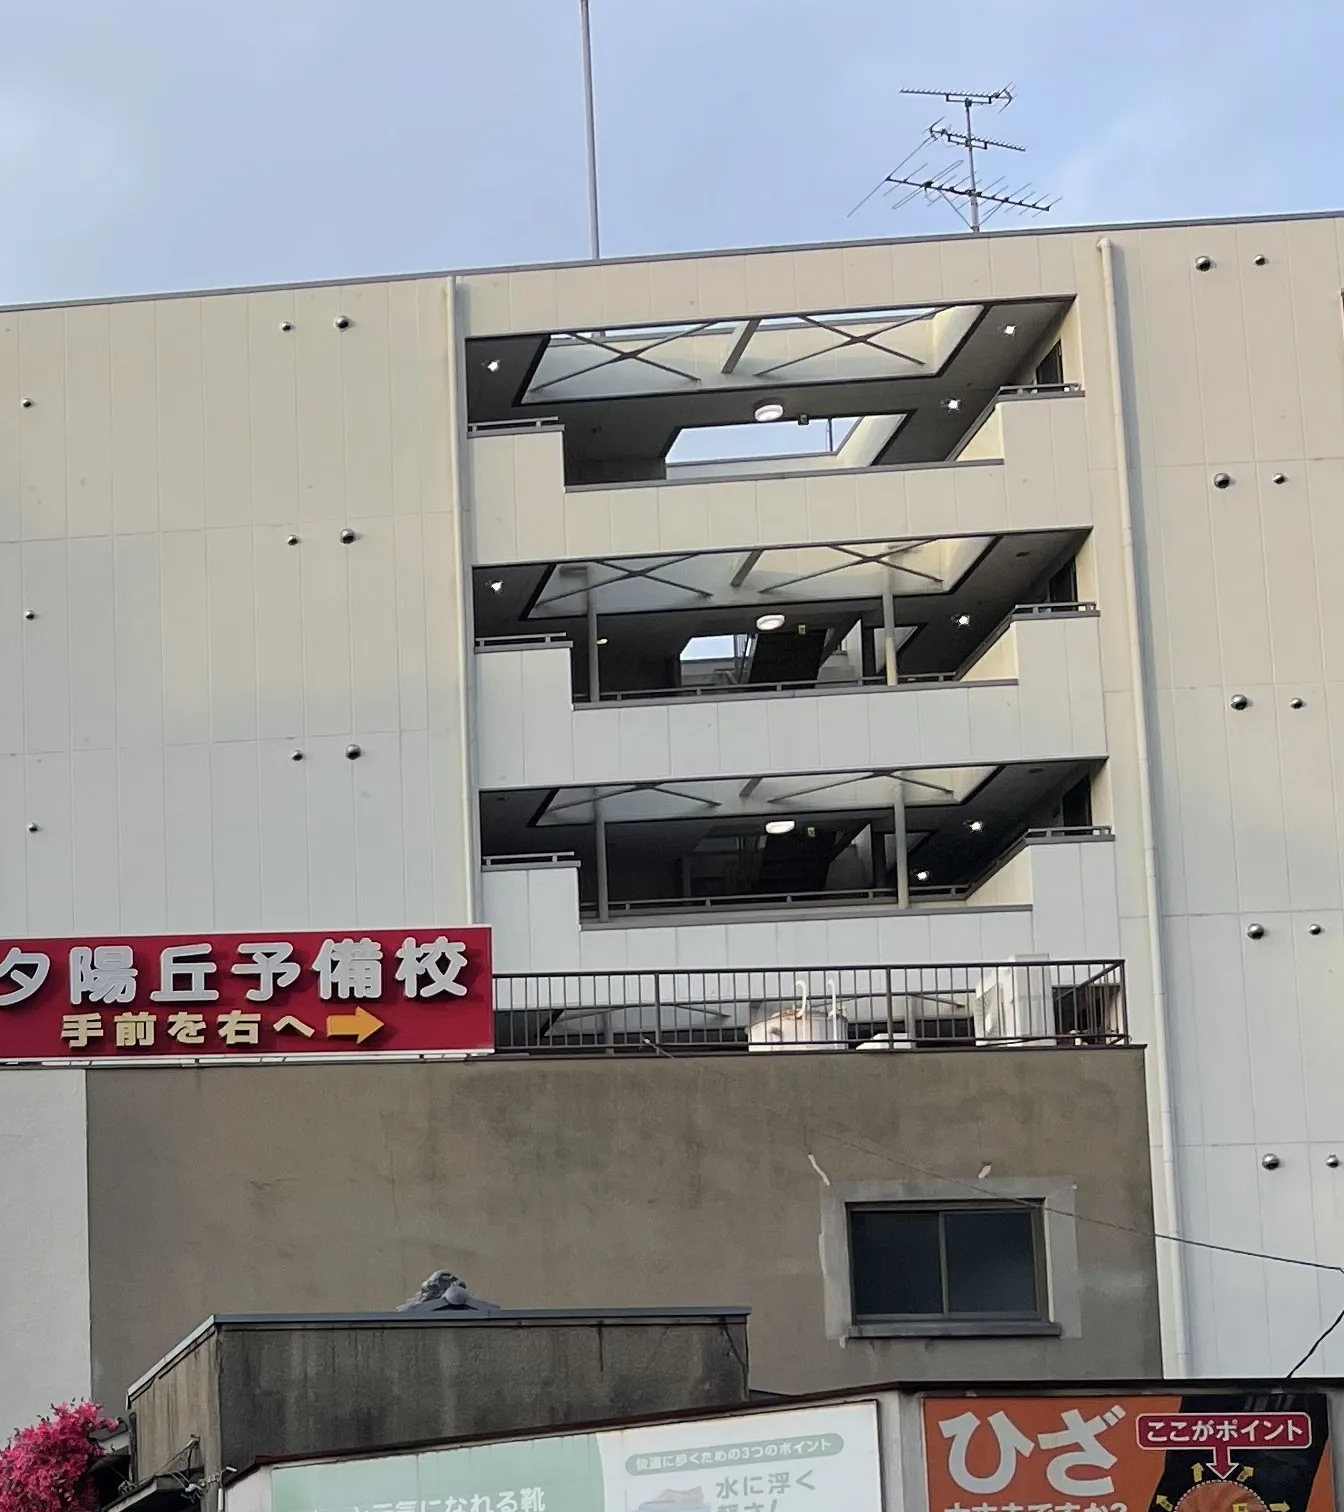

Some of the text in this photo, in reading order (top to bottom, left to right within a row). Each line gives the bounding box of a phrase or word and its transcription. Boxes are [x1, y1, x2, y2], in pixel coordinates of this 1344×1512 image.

[60, 1009, 316, 1048] 手前を右へ
[1146, 1417, 1303, 1443] ここがポイント
[635, 1438, 832, 1471] 快適に歩くための3つのポイント
[937, 1404, 1127, 1496] ひざ
[714, 1469, 816, 1500] 水に浮く
